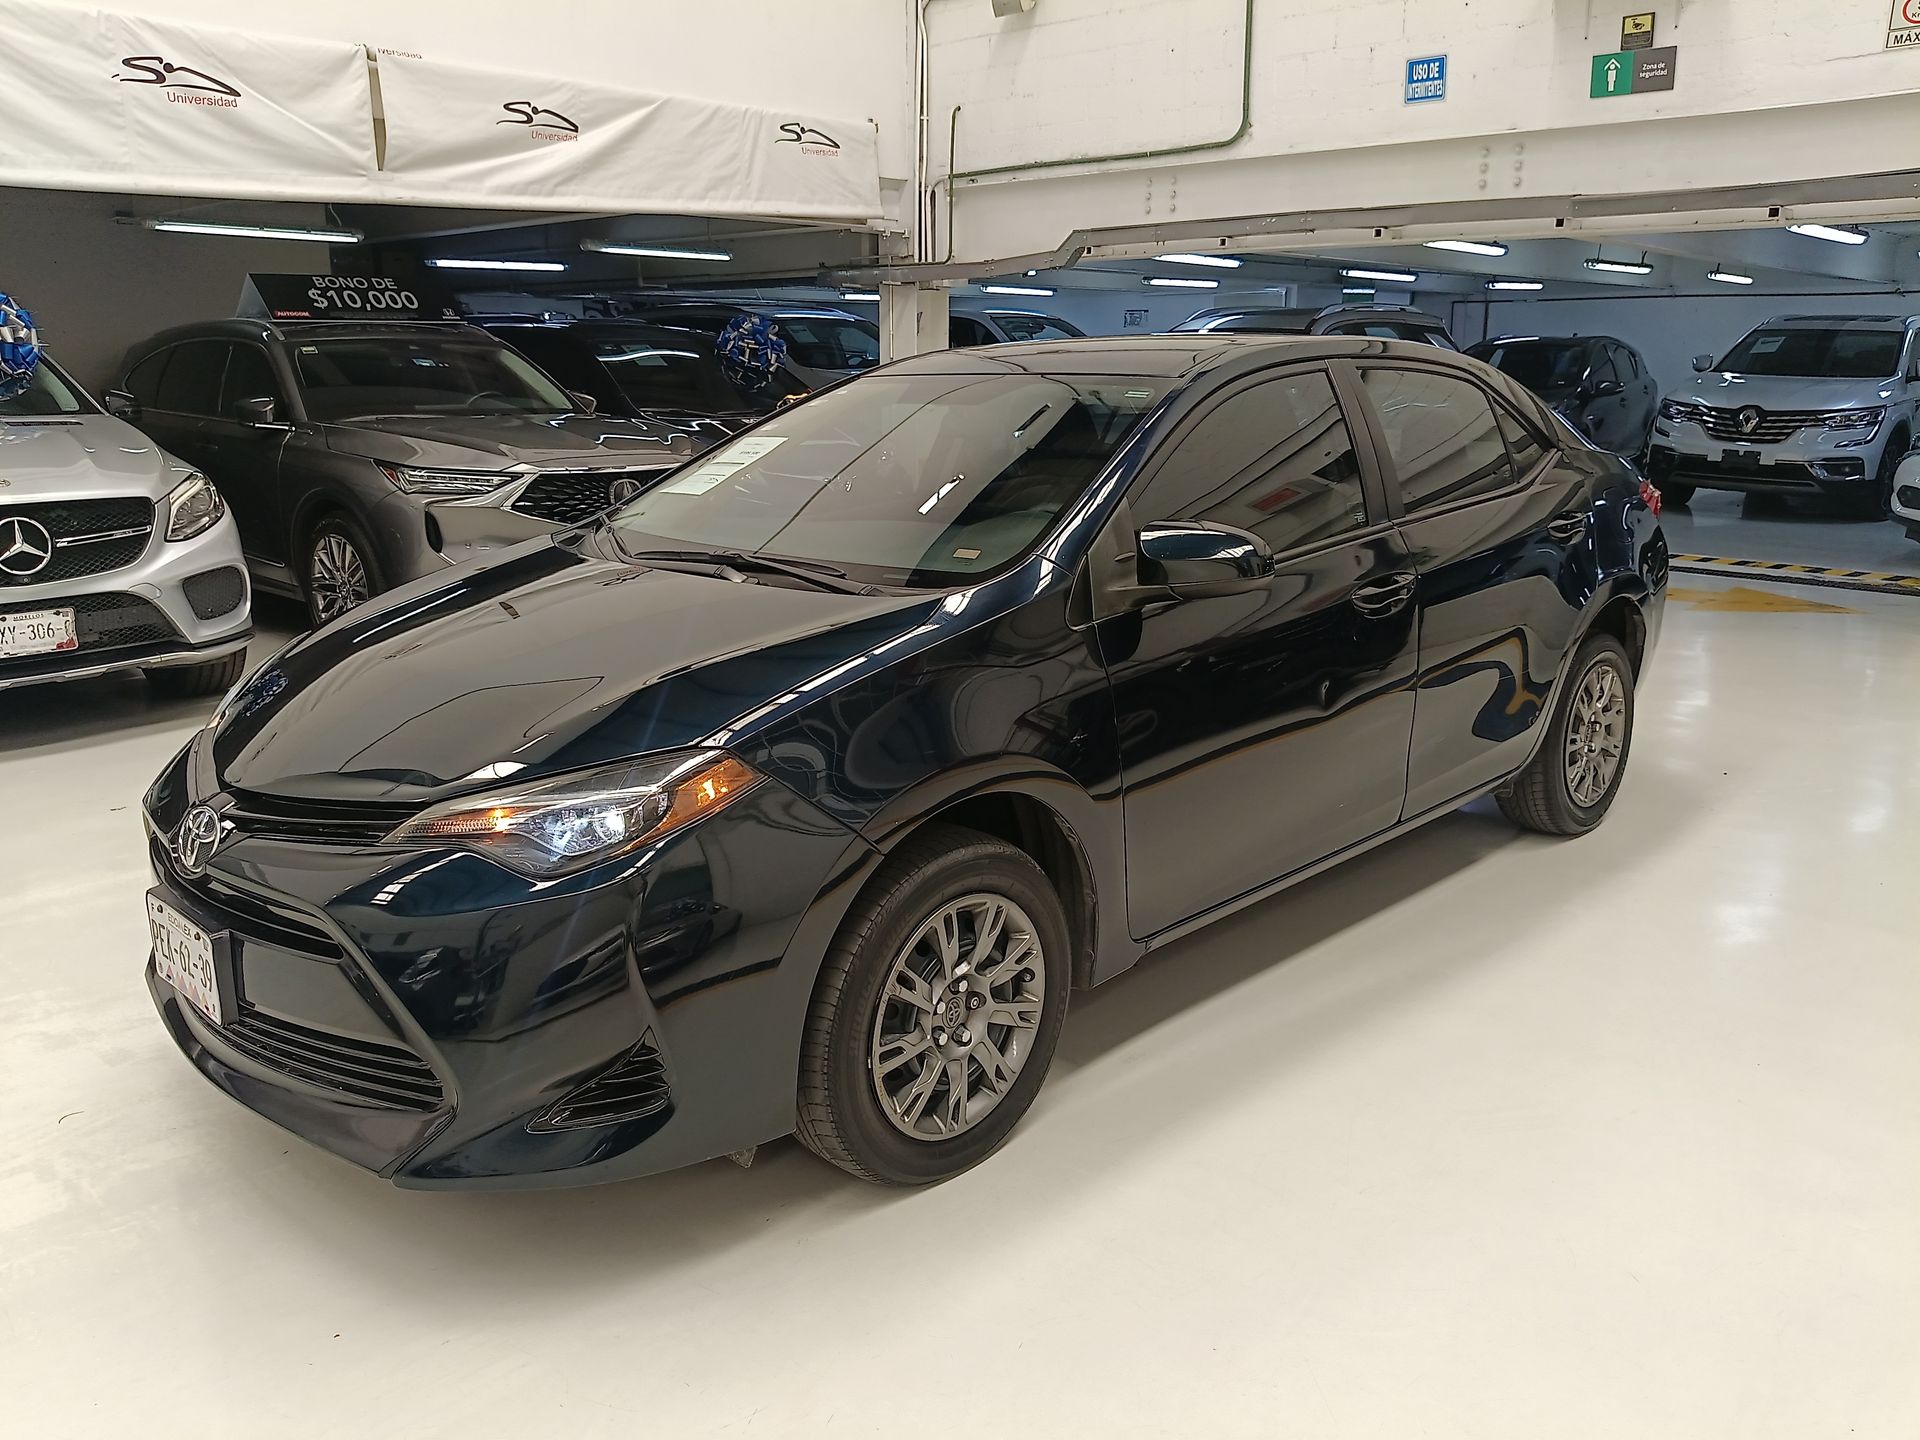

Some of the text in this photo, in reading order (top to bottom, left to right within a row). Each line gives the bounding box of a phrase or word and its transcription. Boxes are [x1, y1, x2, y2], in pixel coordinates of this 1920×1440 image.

[1413, 62, 1440, 80] USO DE
[1639, 69, 1668, 78] seguridad
[1642, 63, 1657, 71] Zona
[166, 91, 238, 107] Universidad
[531, 130, 578, 141] Universidad
[312, 276, 398, 289] BONO DE
[308, 288, 419, 311] $10,000
